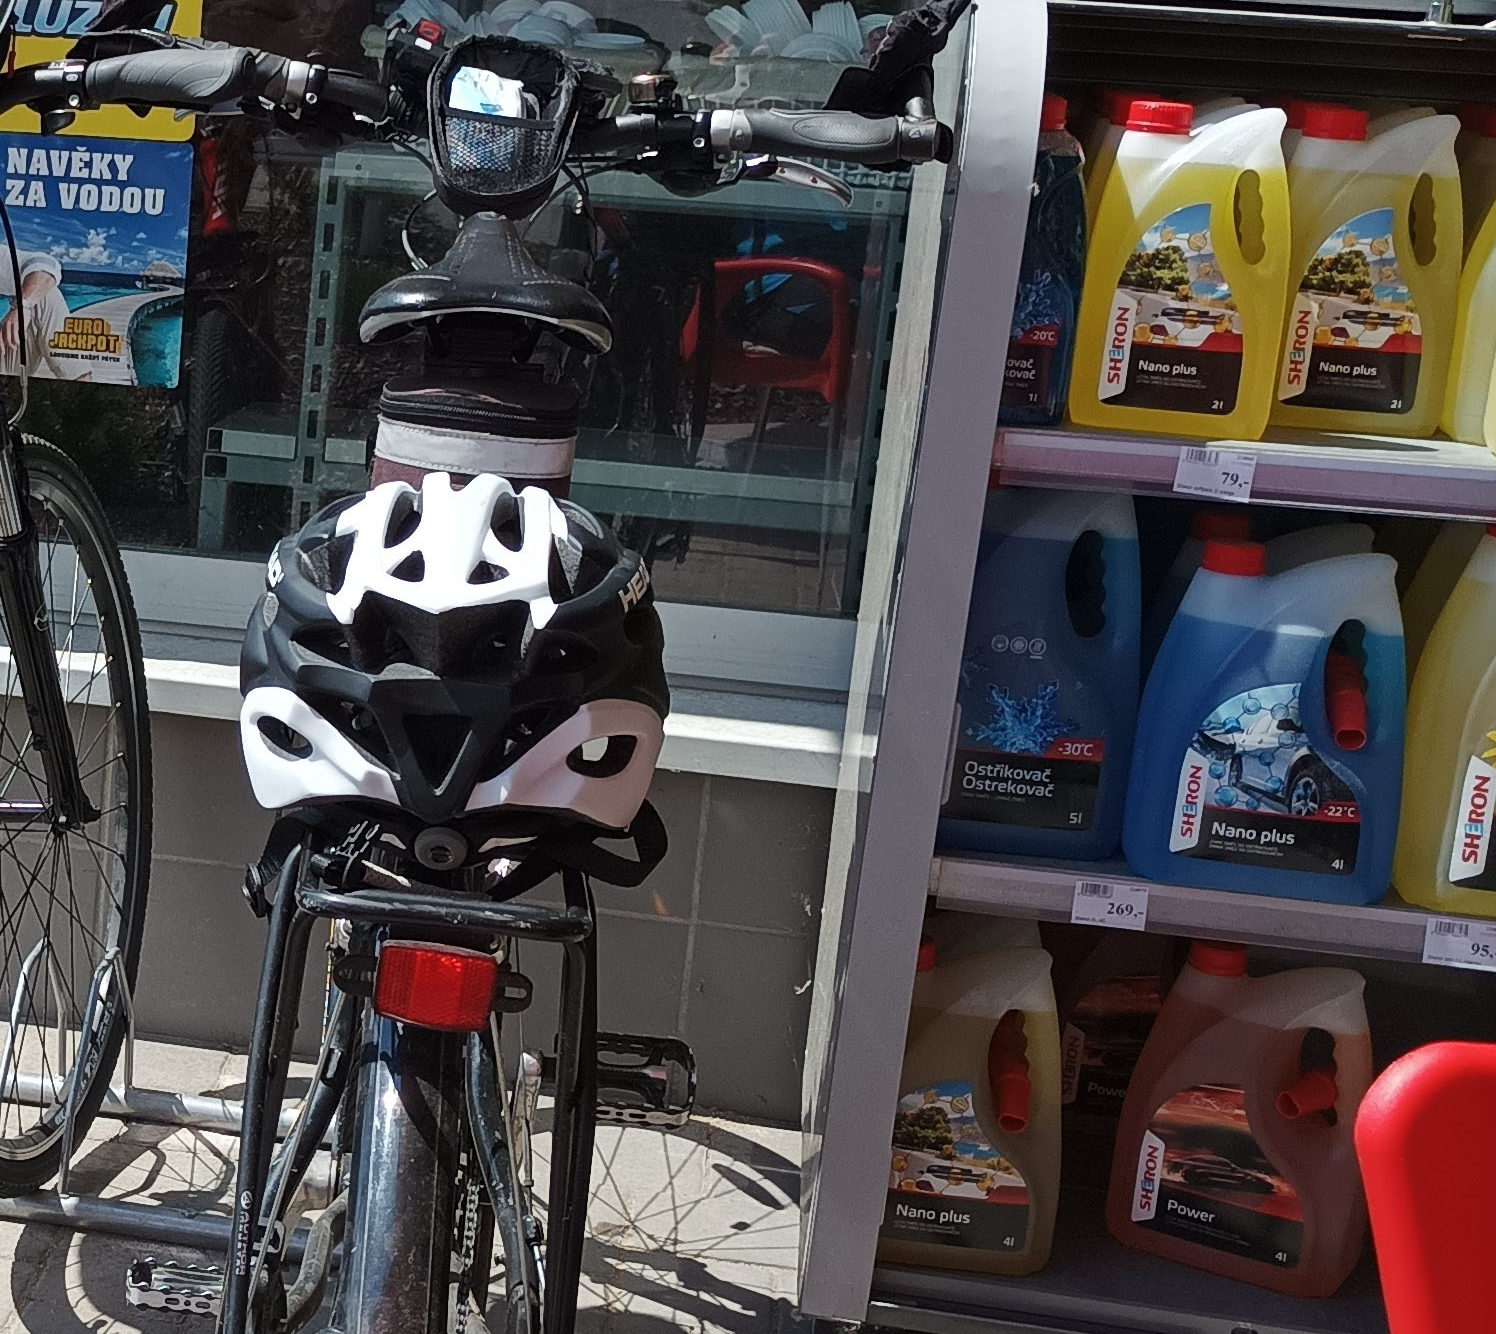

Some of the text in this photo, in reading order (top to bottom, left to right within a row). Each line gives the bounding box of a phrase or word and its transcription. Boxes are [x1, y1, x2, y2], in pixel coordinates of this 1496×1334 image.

[7, 145, 134, 182] NAVĚKY
[5, 178, 166, 217] ZA VODOU
[64, 317, 104, 336] EURO
[49, 332, 118, 353] JACKPOT
[1107, 306, 1131, 385] SHERON
[1287, 310, 1312, 386] SHERON
[1138, 359, 1198, 376] Nano plus
[1319, 361, 1377, 376] Nano plus
[617, 555, 651, 615] HEA
[964, 760, 1052, 783] Ostřikovač
[962, 775, 1055, 798] Ostrekovač
[1180, 764, 1204, 839] SHERON
[1461, 774, 1492, 865] SHERON
[1210, 820, 1296, 846] Nano plus
[1087, 1080, 1127, 1099] Powe
[1139, 1144, 1160, 1212] SHERON
[895, 1203, 972, 1225] Nano plus
[1167, 1199, 1216, 1223] Power
